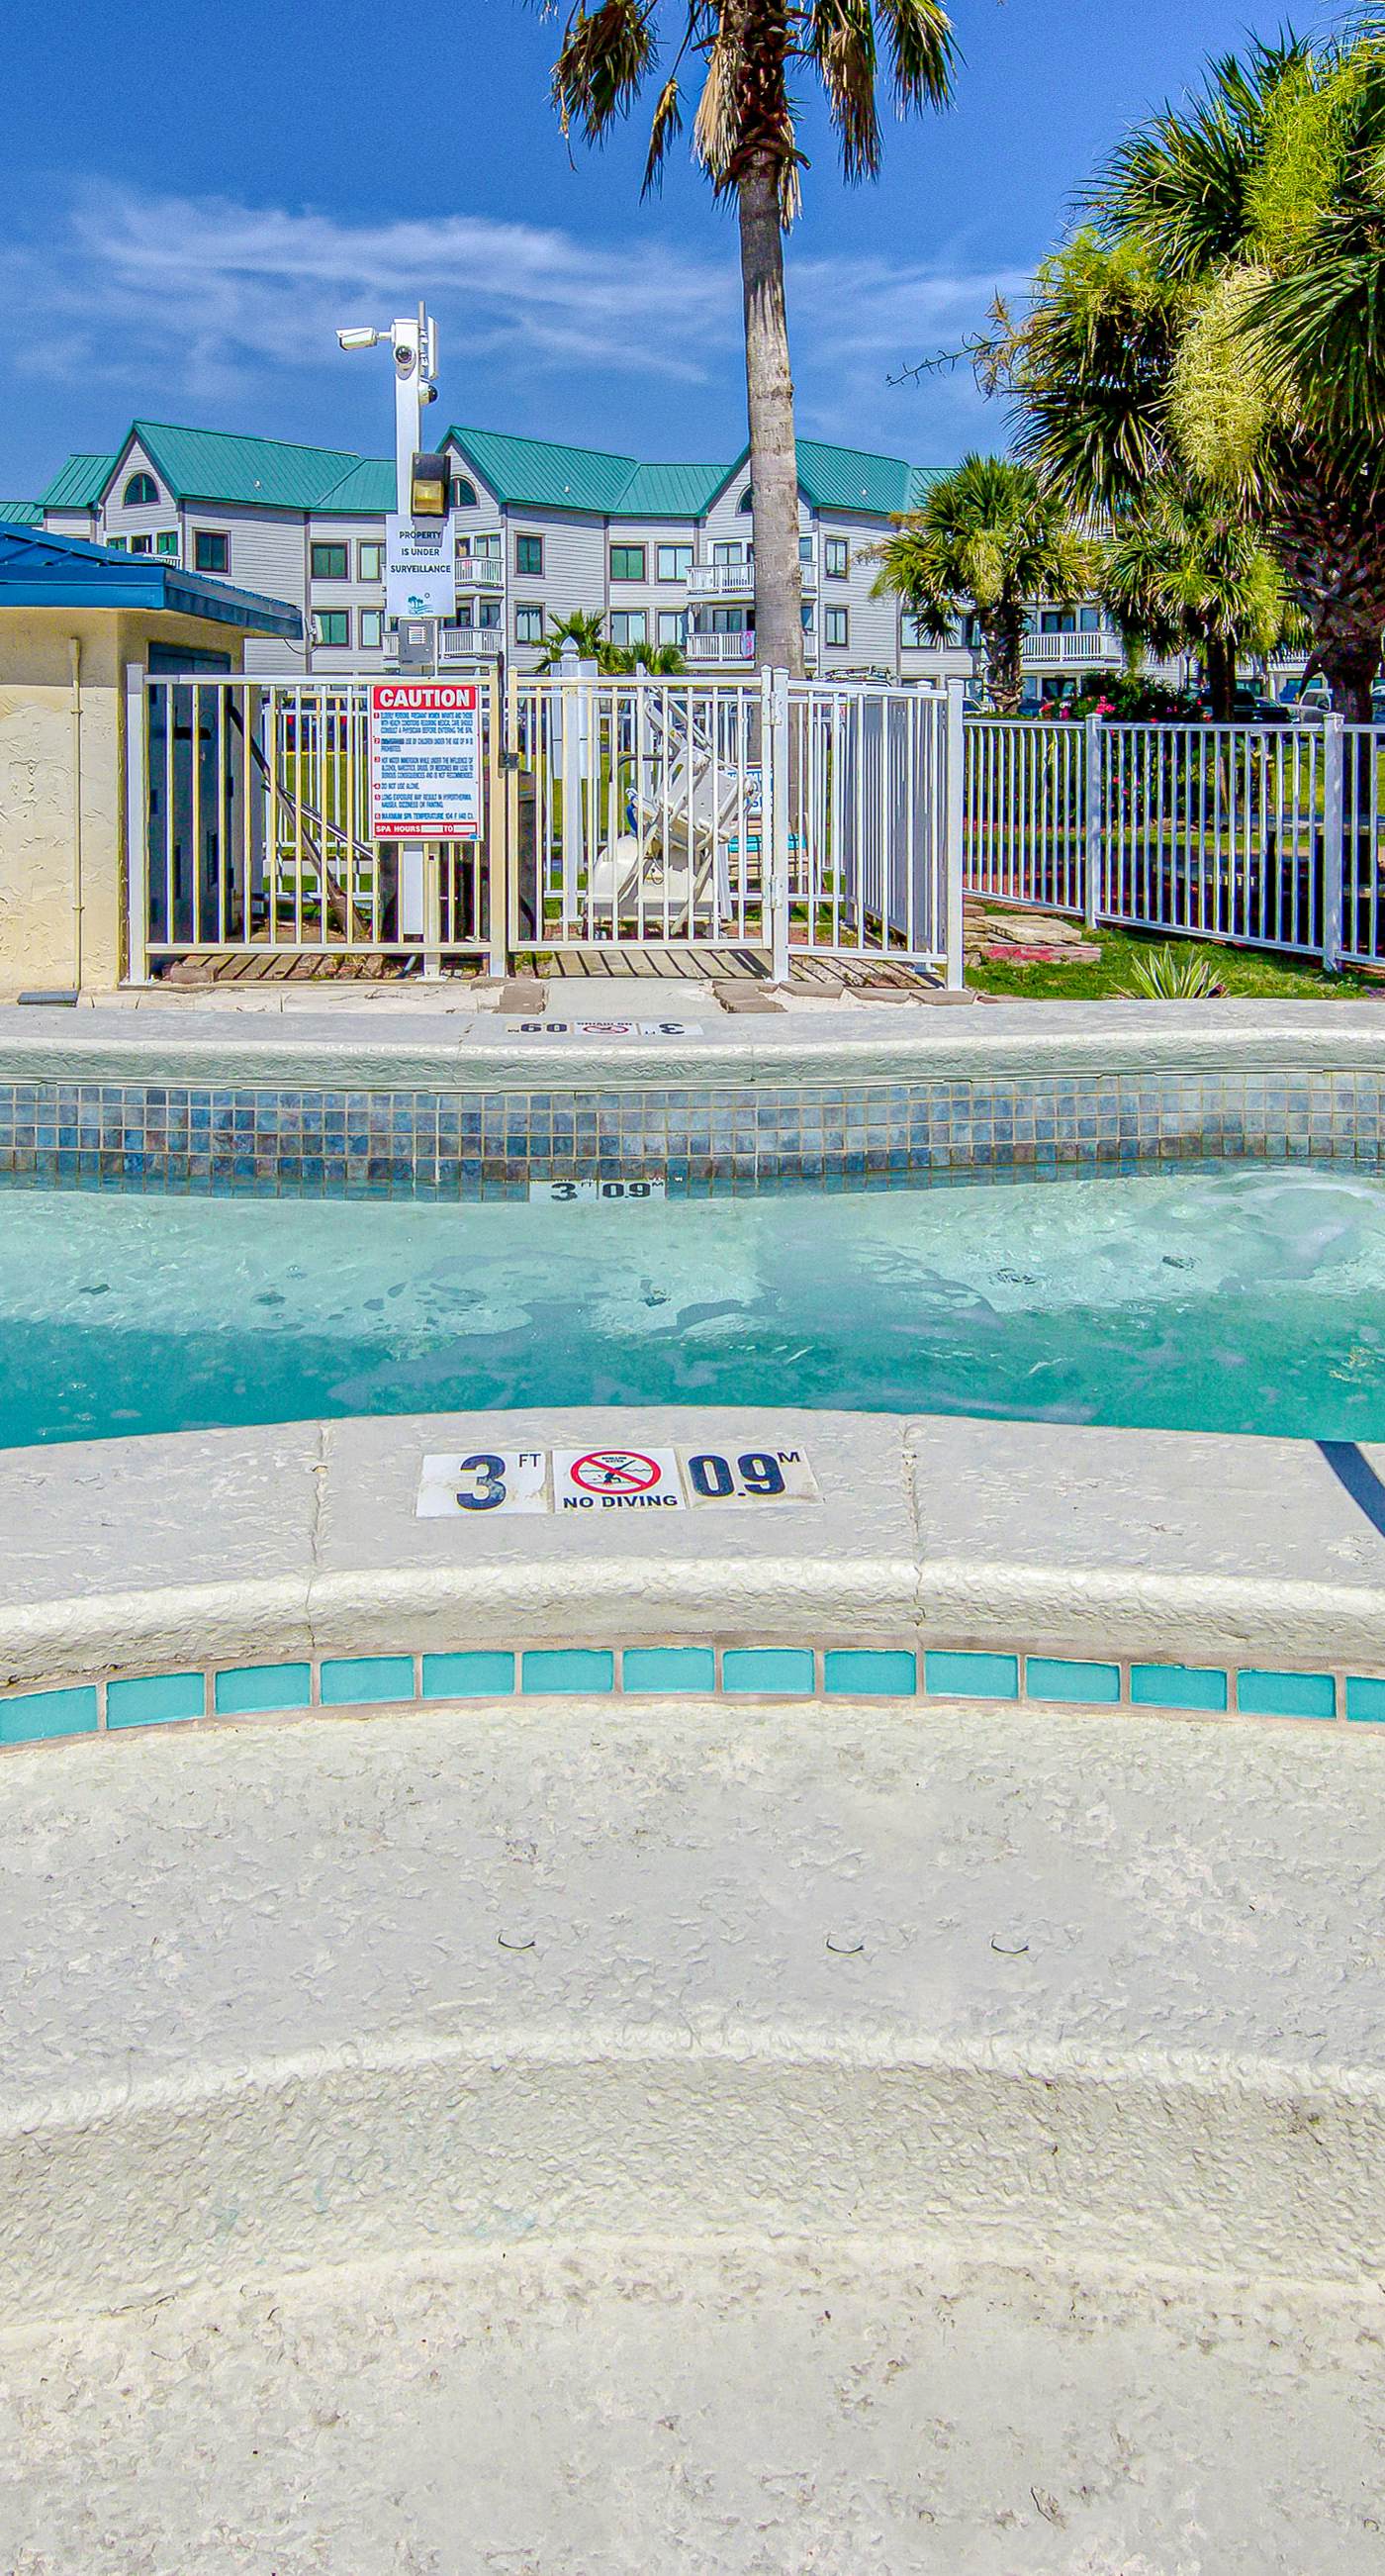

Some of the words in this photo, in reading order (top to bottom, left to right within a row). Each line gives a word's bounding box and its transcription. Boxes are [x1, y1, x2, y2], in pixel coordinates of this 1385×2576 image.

[399, 530, 442, 539] PROPERTY
[390, 564, 451, 573] SURVEILLANCE
[379, 688, 470, 708] CAUTION
[550, 1182, 579, 1201] 3
[601, 1182, 651, 1198] 0.9
[456, 1454, 508, 1510] 3
[518, 1453, 542, 1469] FT
[688, 1453, 785, 1498] 0.9
[778, 1451, 801, 1465] M
[563, 1496, 594, 1509] NO
[601, 1494, 679, 1508] DIVING
